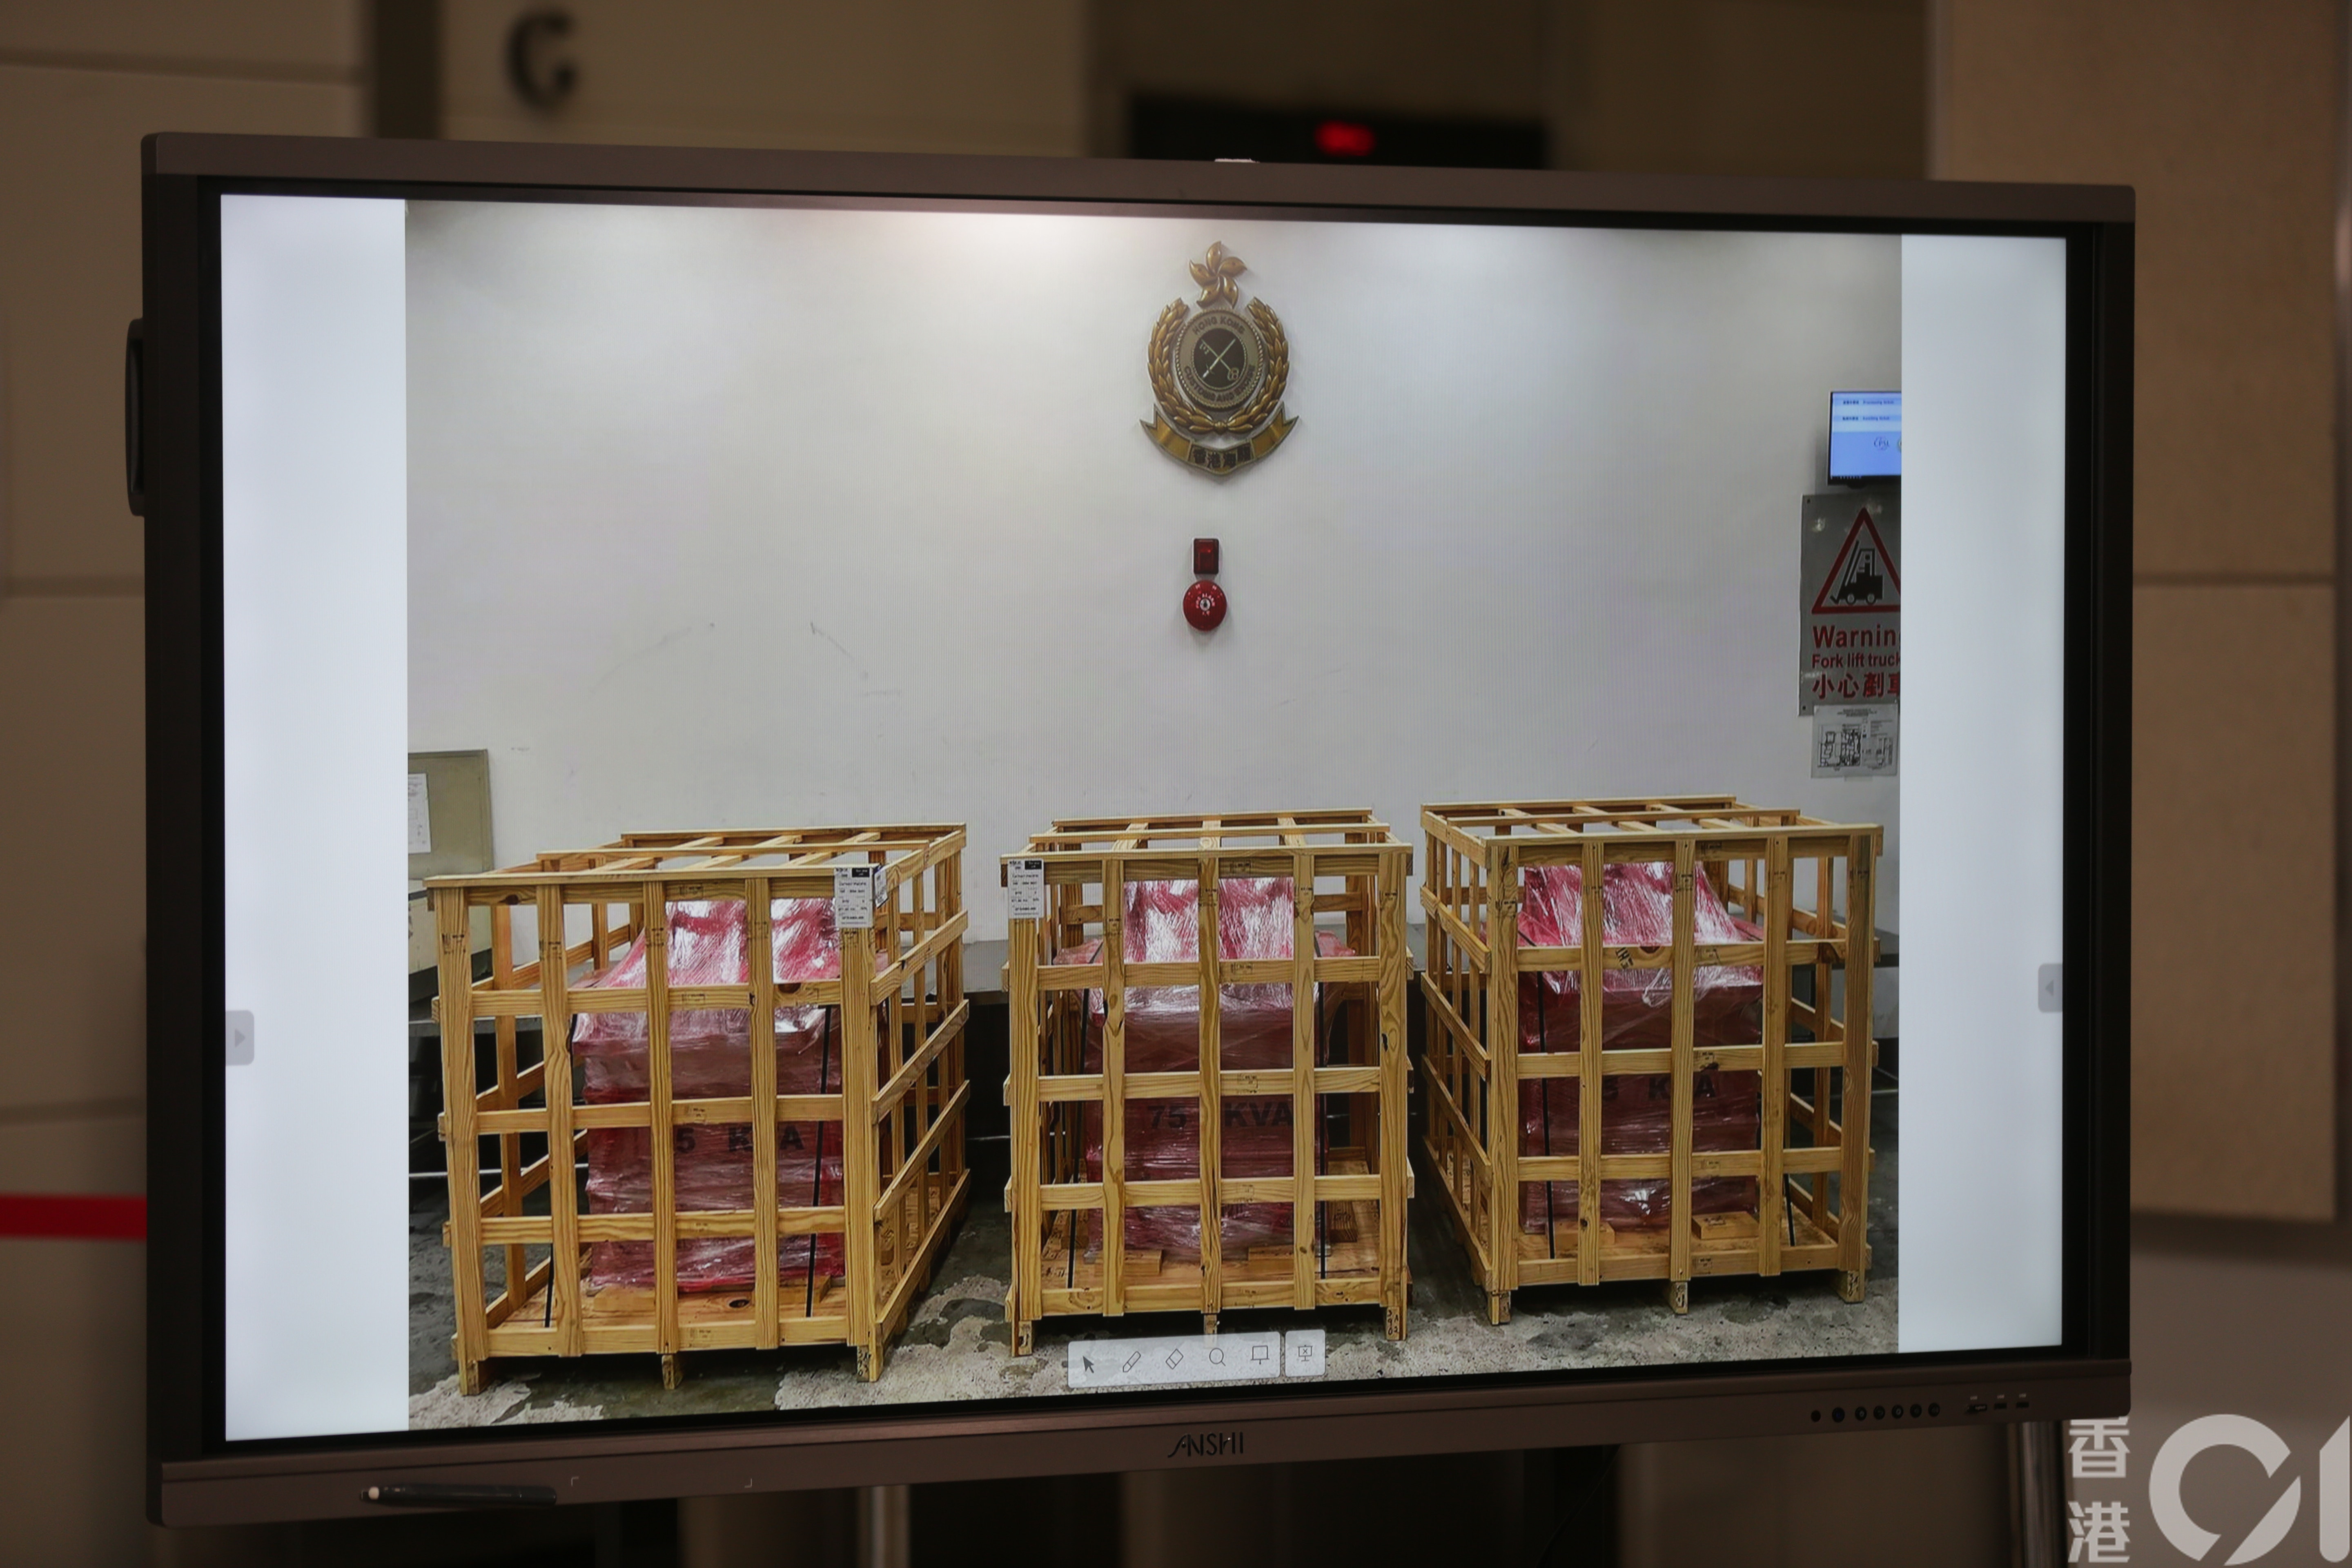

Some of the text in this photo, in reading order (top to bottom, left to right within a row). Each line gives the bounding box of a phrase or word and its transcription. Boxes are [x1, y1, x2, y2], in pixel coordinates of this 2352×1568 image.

[1192, 316, 1246, 335] HONG KONG
[1215, 391, 1236, 403] AND
[1812, 623, 1900, 648] Warnin
[1812, 653, 1843, 669] Fork
[1847, 652, 1865, 668] lift
[1648, 1074, 1717, 1100] KA
[1147, 1100, 1294, 1130] 75 KVA
[675, 1125, 804, 1154] 5 KA
[1167, 1431, 1244, 1458] ANSHI
